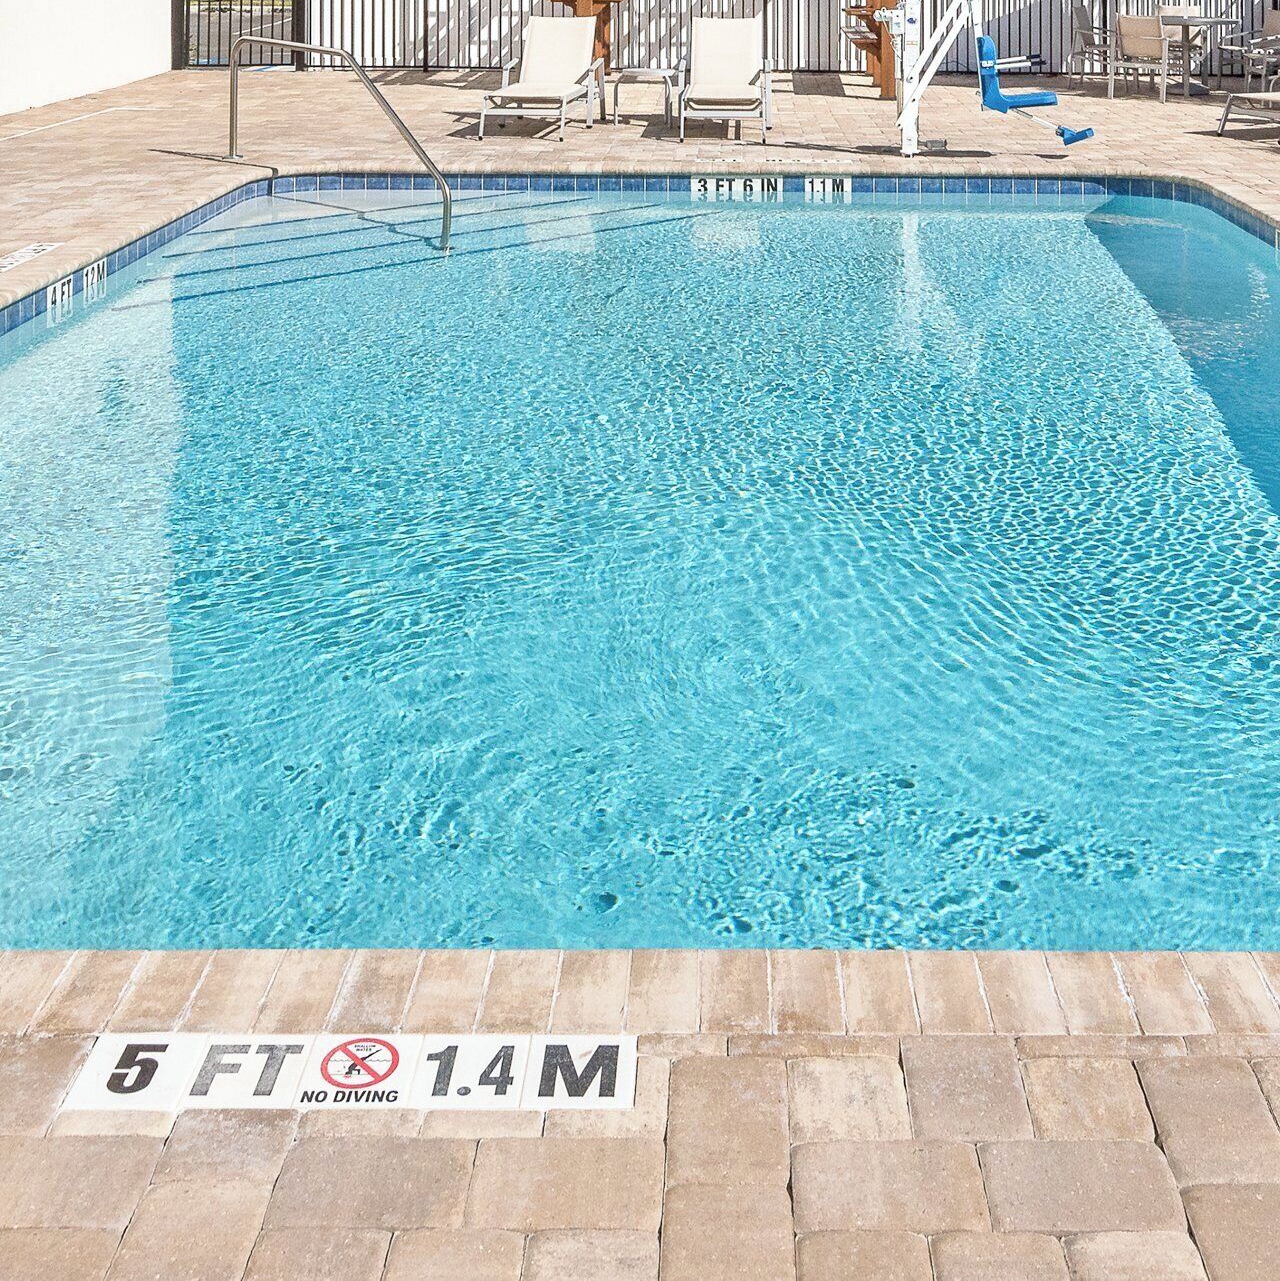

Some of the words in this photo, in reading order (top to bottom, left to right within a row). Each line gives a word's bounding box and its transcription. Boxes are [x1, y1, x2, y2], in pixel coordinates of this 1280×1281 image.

[697, 178, 708, 192] 3
[715, 178, 736, 192] FT
[743, 178, 754, 192] 6
[761, 178, 778, 192] IN
[96, 261, 105, 282] M
[51, 286, 57, 306] 4
[60, 278, 71, 302] FT
[106, 1043, 169, 1094] 5
[189, 1043, 305, 1097] FT
[426, 1044, 514, 1097] 1.4
[537, 1043, 620, 1098] M
[300, 1090, 328, 1103] NO
[333, 1090, 399, 1103] DIVING
